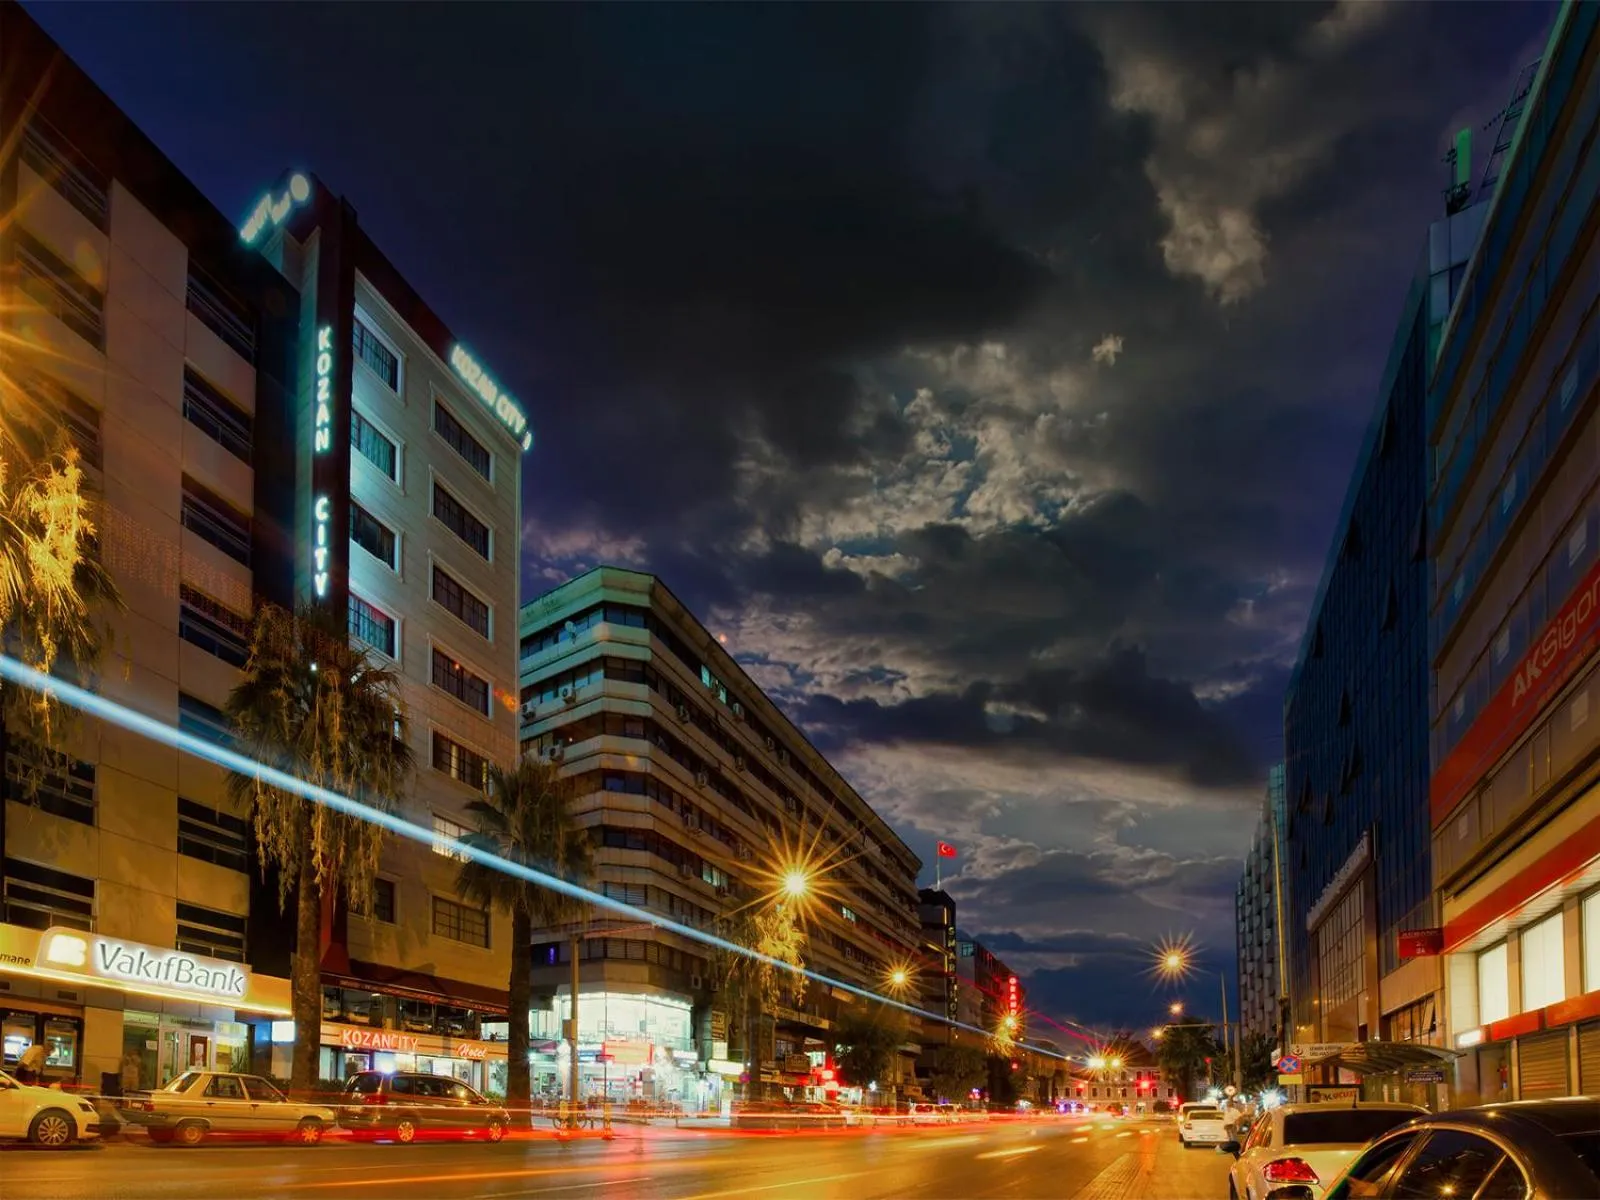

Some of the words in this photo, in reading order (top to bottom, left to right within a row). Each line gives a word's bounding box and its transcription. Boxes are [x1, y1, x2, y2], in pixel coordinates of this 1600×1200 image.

[315, 326, 332, 452] KOZAN
[314, 497, 330, 597] CITY
[457, 1042, 487, 1058] Hotel
